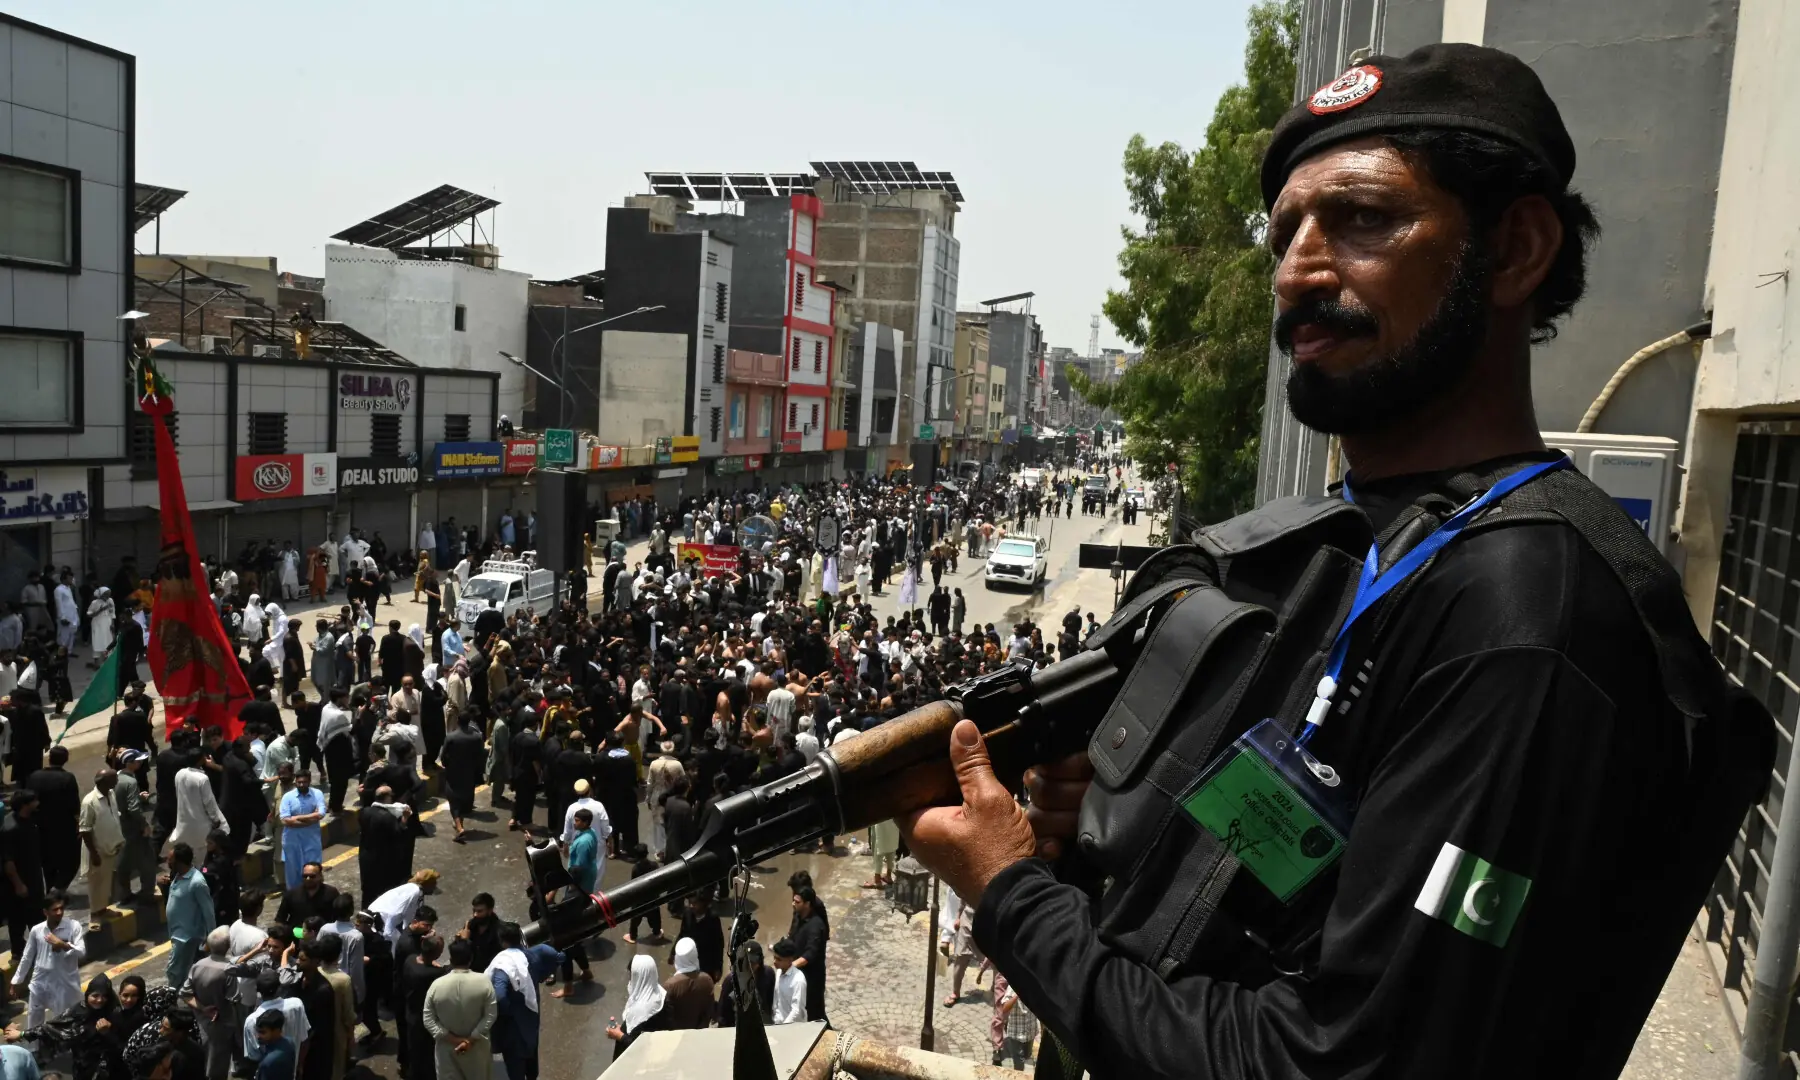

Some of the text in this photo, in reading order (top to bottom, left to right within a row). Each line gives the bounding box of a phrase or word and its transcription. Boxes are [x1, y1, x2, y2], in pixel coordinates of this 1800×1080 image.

[342, 398, 374, 411] Beauty
[510, 443, 536, 456] JAVED
[378, 467, 418, 484] STUDIO
[1238, 792, 1268, 819] Police
[1271, 790, 1295, 813] 2026
